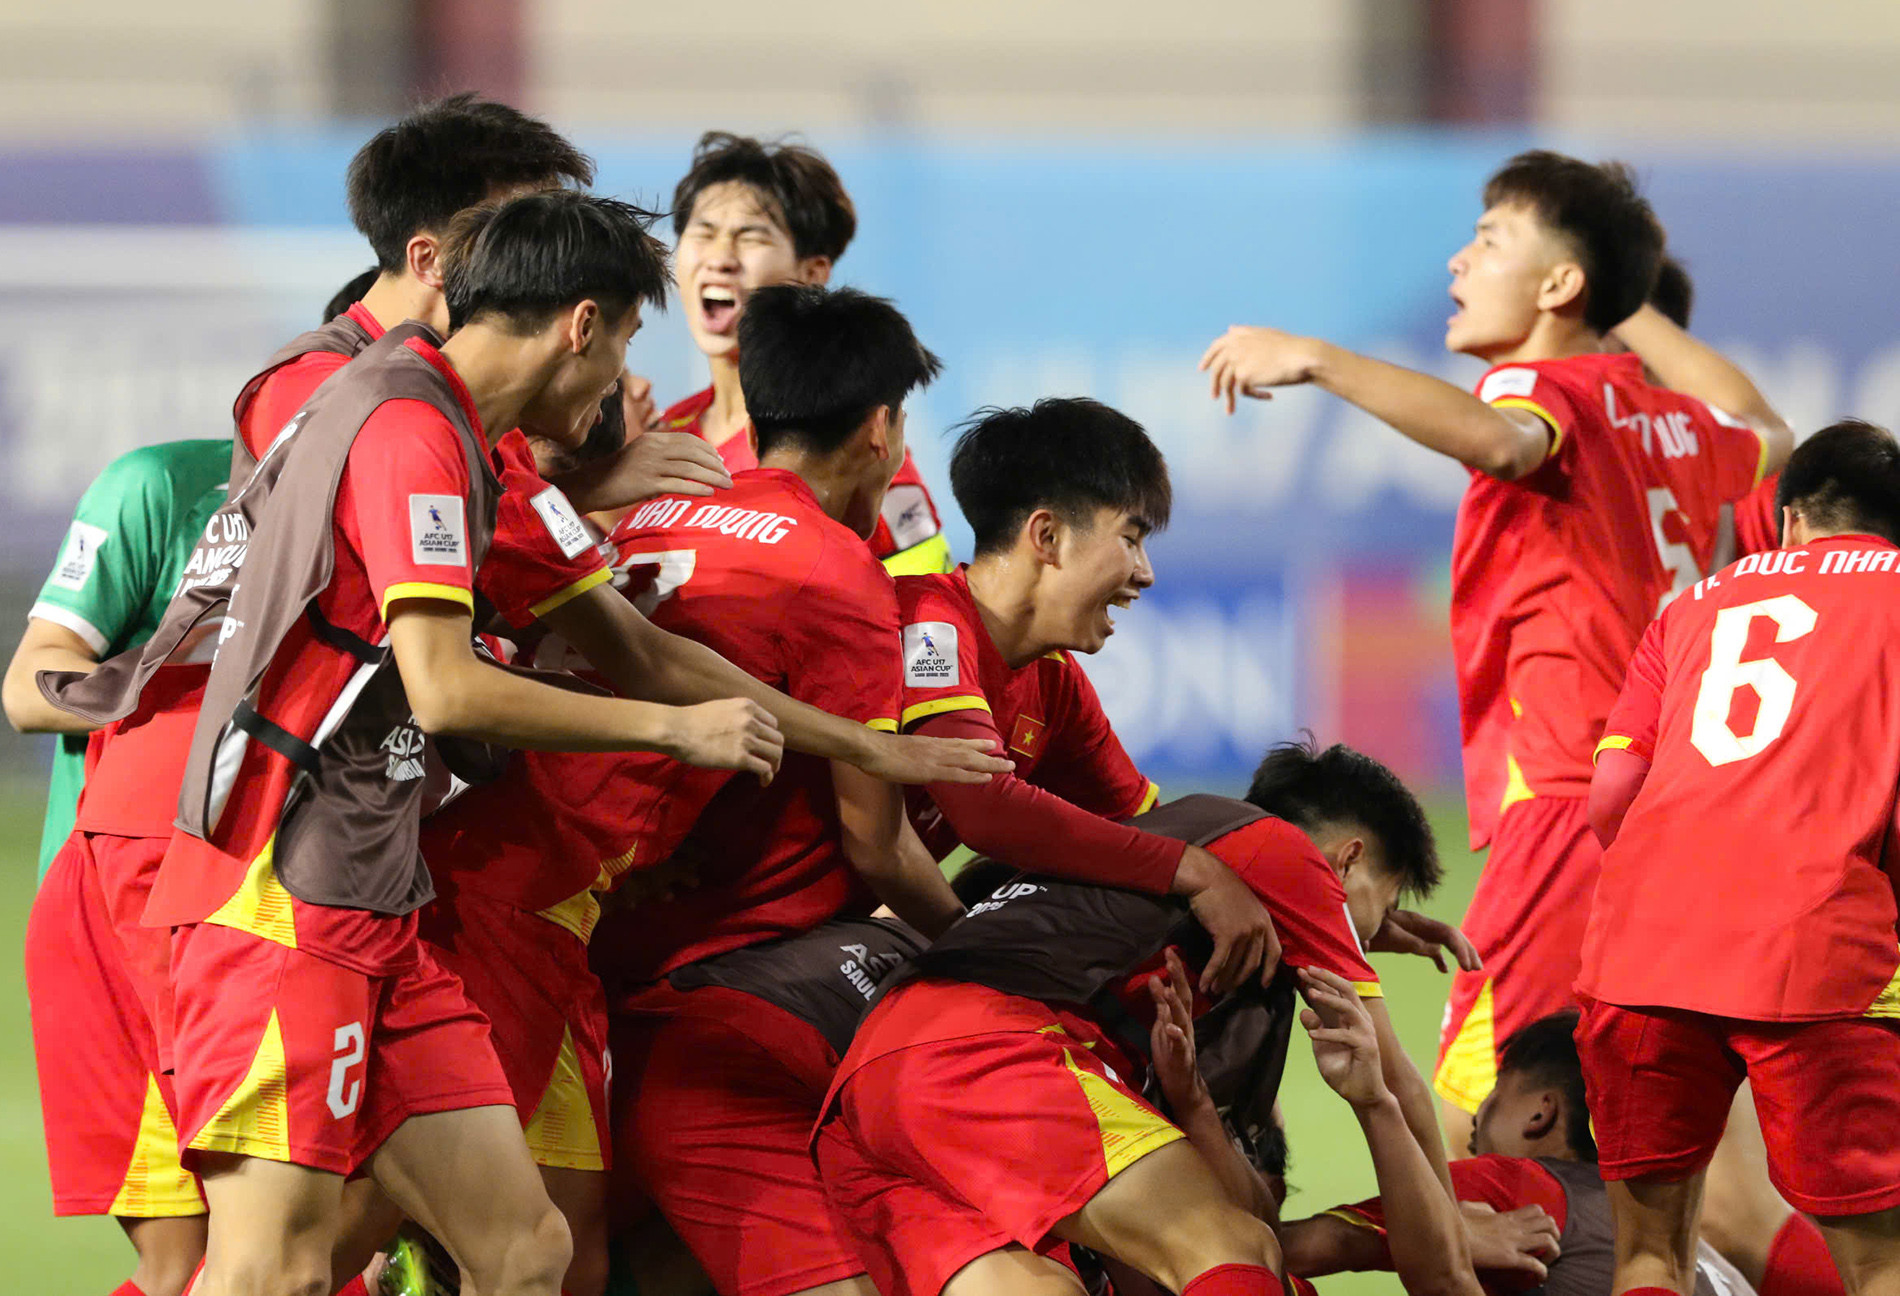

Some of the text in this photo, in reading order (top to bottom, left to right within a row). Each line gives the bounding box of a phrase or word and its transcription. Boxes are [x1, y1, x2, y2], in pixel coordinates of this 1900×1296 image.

[424, 533, 454, 541] AFC U17
[627, 498, 692, 530] VAN
[684, 505, 798, 545] DUONG
[1733, 550, 1810, 578] DUC
[1690, 594, 1819, 768] 6
[326, 1021, 365, 1120] 2
